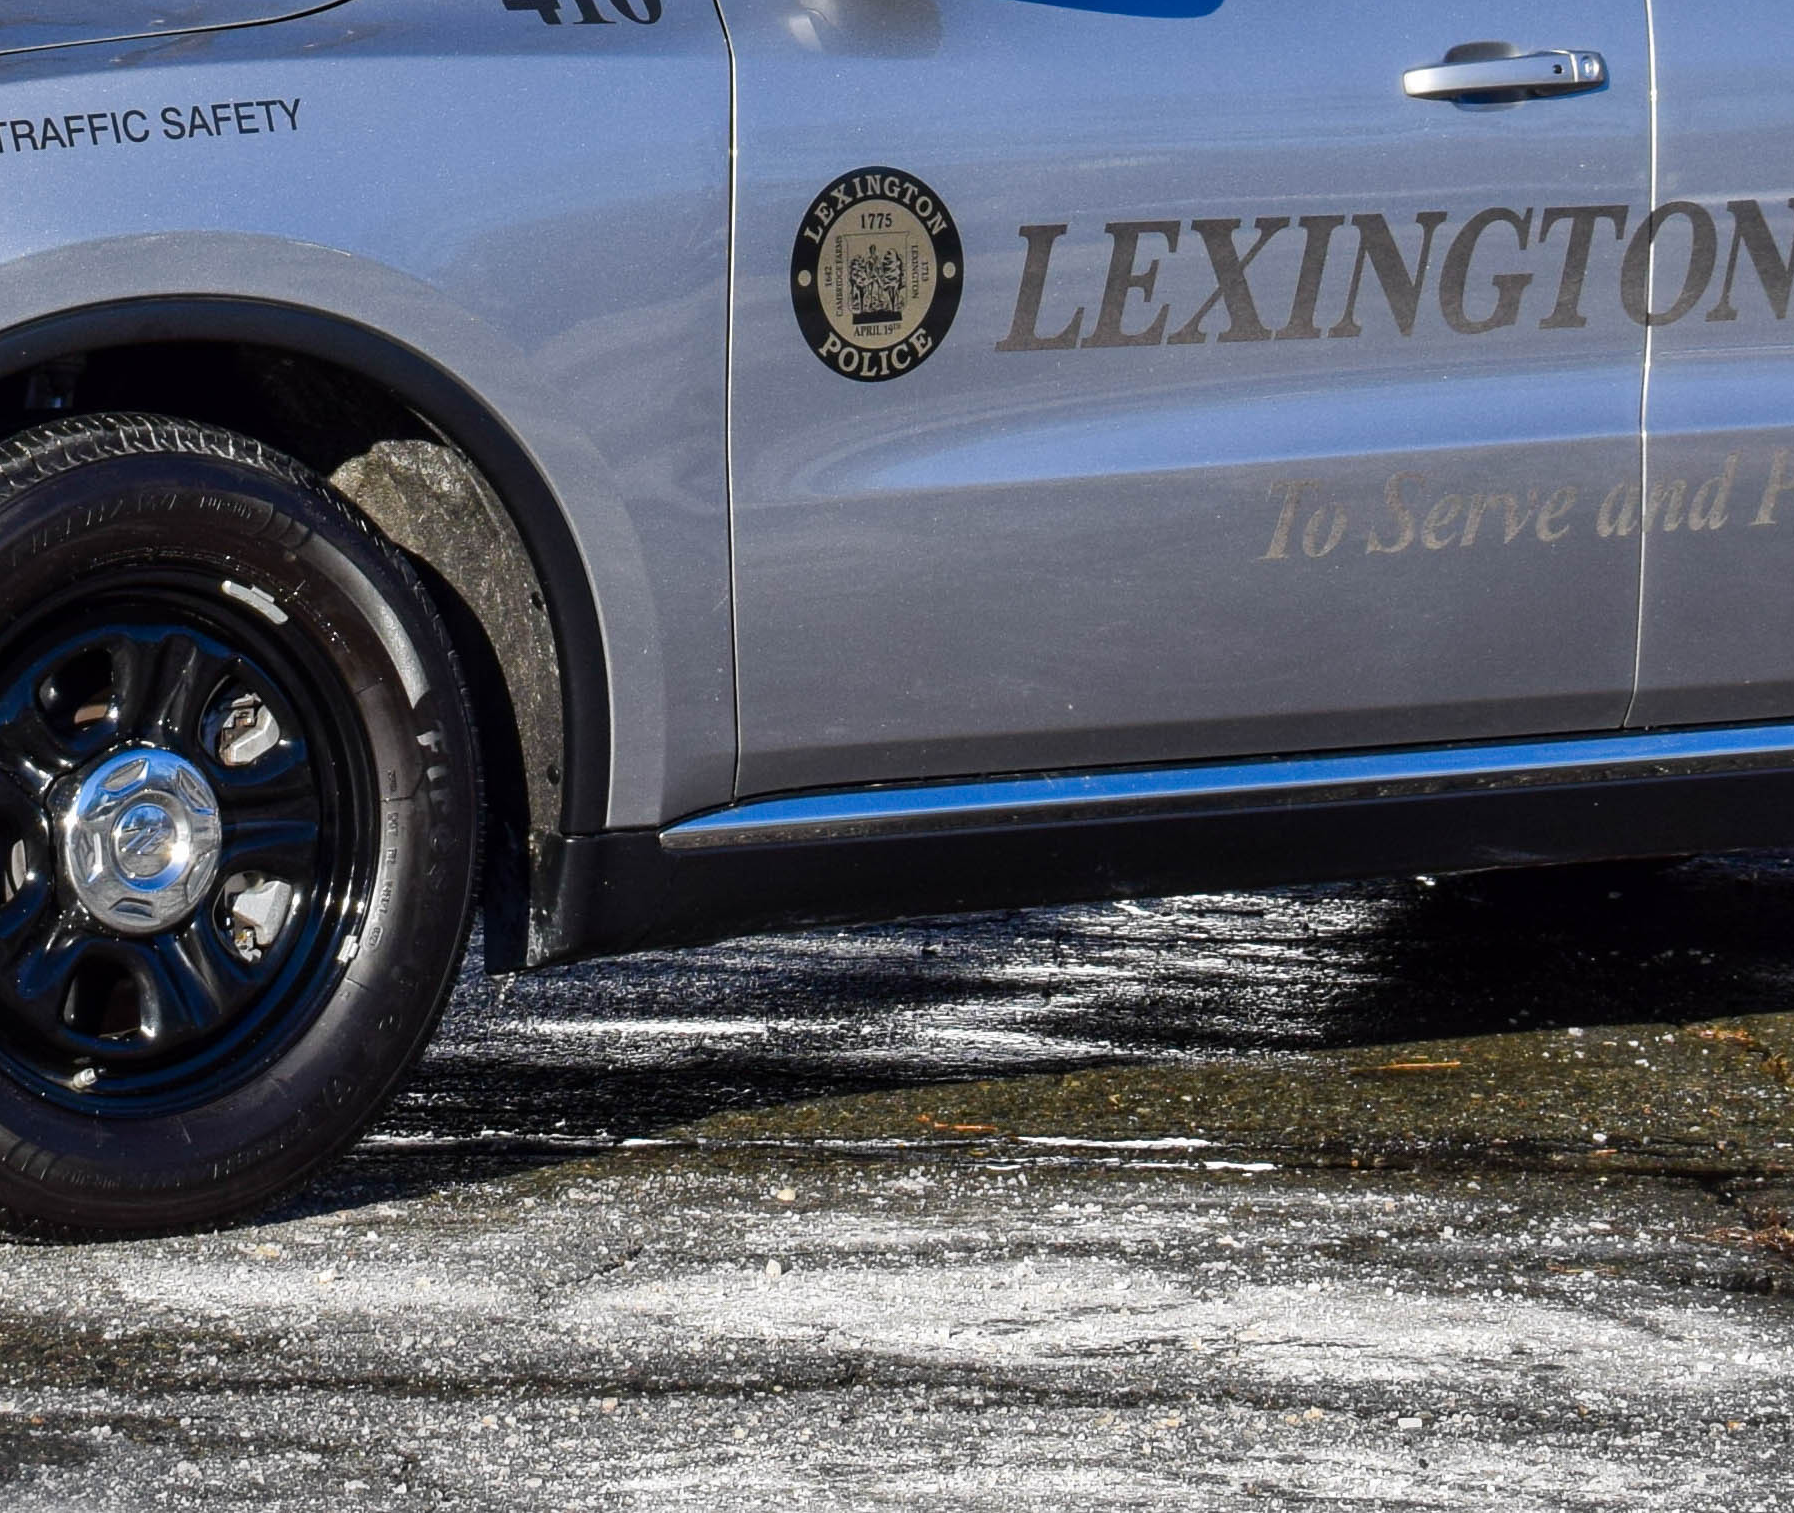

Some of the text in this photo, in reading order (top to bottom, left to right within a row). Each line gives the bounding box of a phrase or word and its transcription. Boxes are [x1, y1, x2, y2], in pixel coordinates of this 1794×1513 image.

[160, 98, 302, 141] SAFETY
[803, 173, 948, 244] LEXINGTON
[861, 213, 893, 230] 1775
[818, 327, 933, 377] POLICE
[853, 325, 882, 337] APRIL
[1258, 476, 1348, 561] To
[1364, 469, 1578, 556] Serve
[1595, 448, 1742, 539] and
